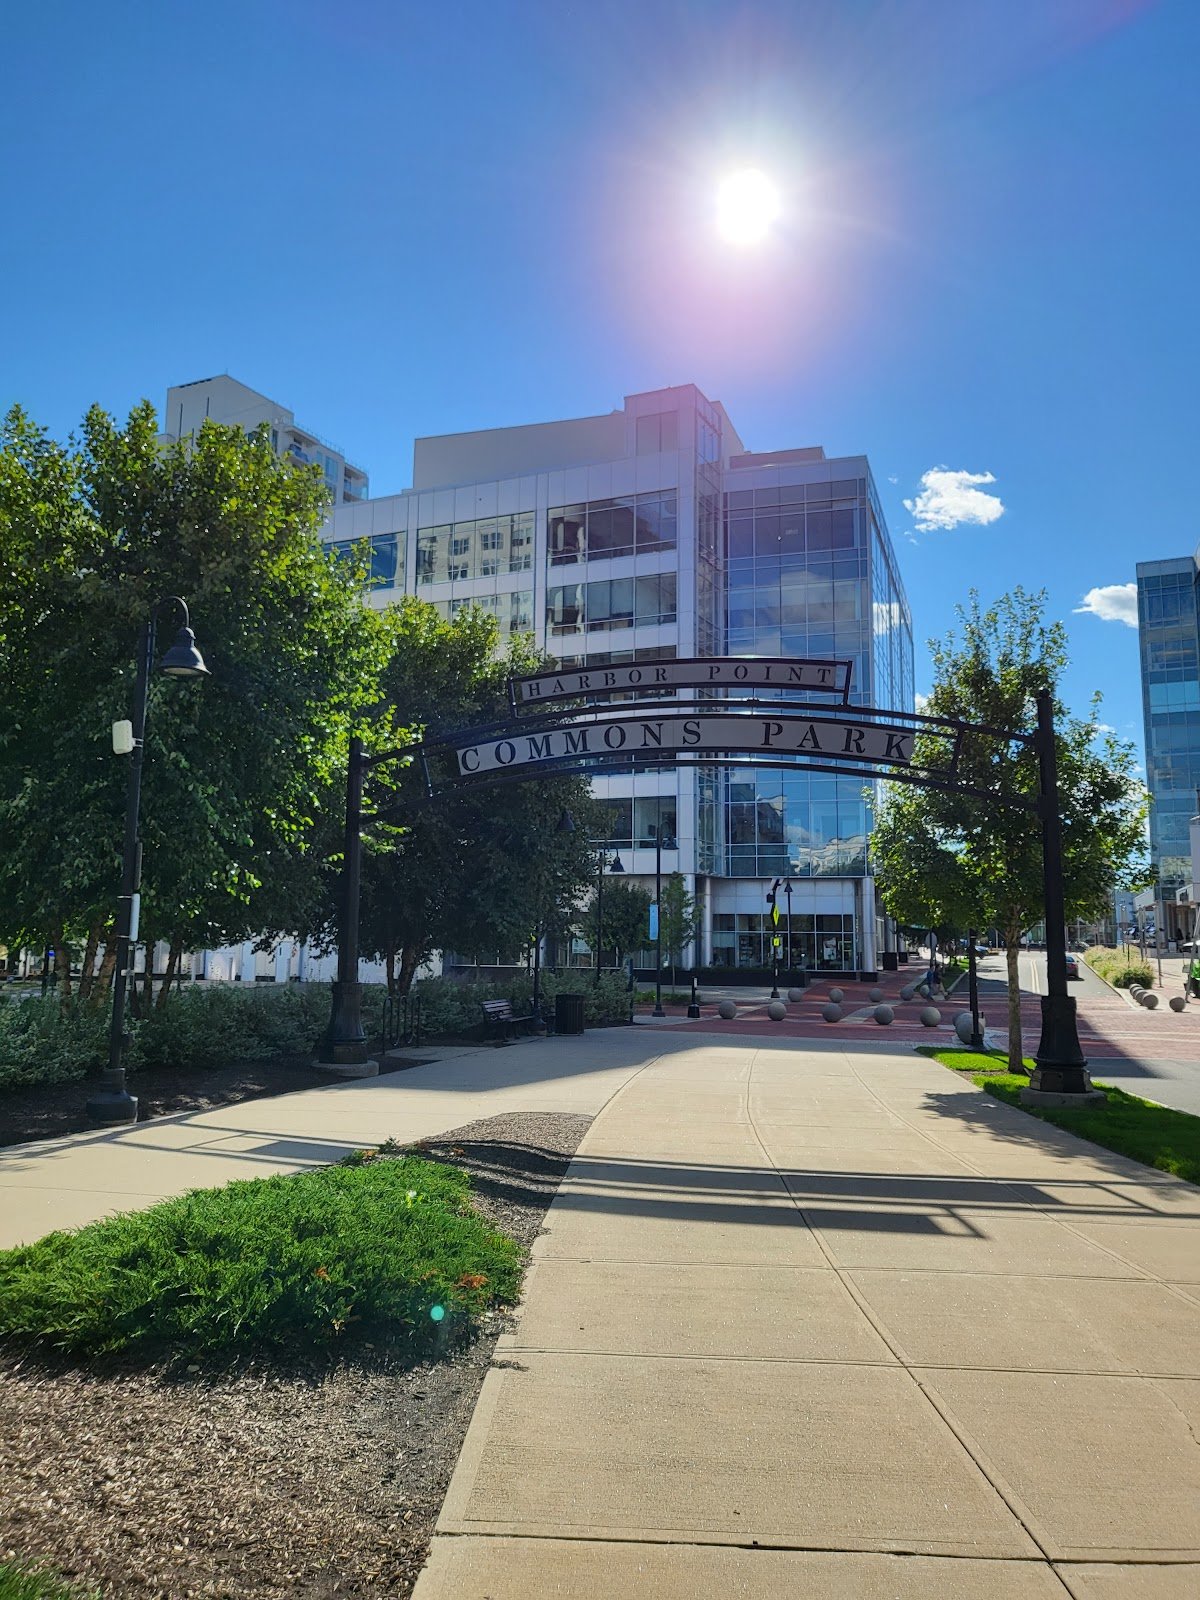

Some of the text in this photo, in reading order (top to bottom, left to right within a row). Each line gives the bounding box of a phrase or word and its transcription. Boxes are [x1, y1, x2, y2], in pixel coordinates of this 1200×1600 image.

[528, 665, 831, 698] HARBOR POINT
[461, 720, 910, 772] COMMONS PARK
